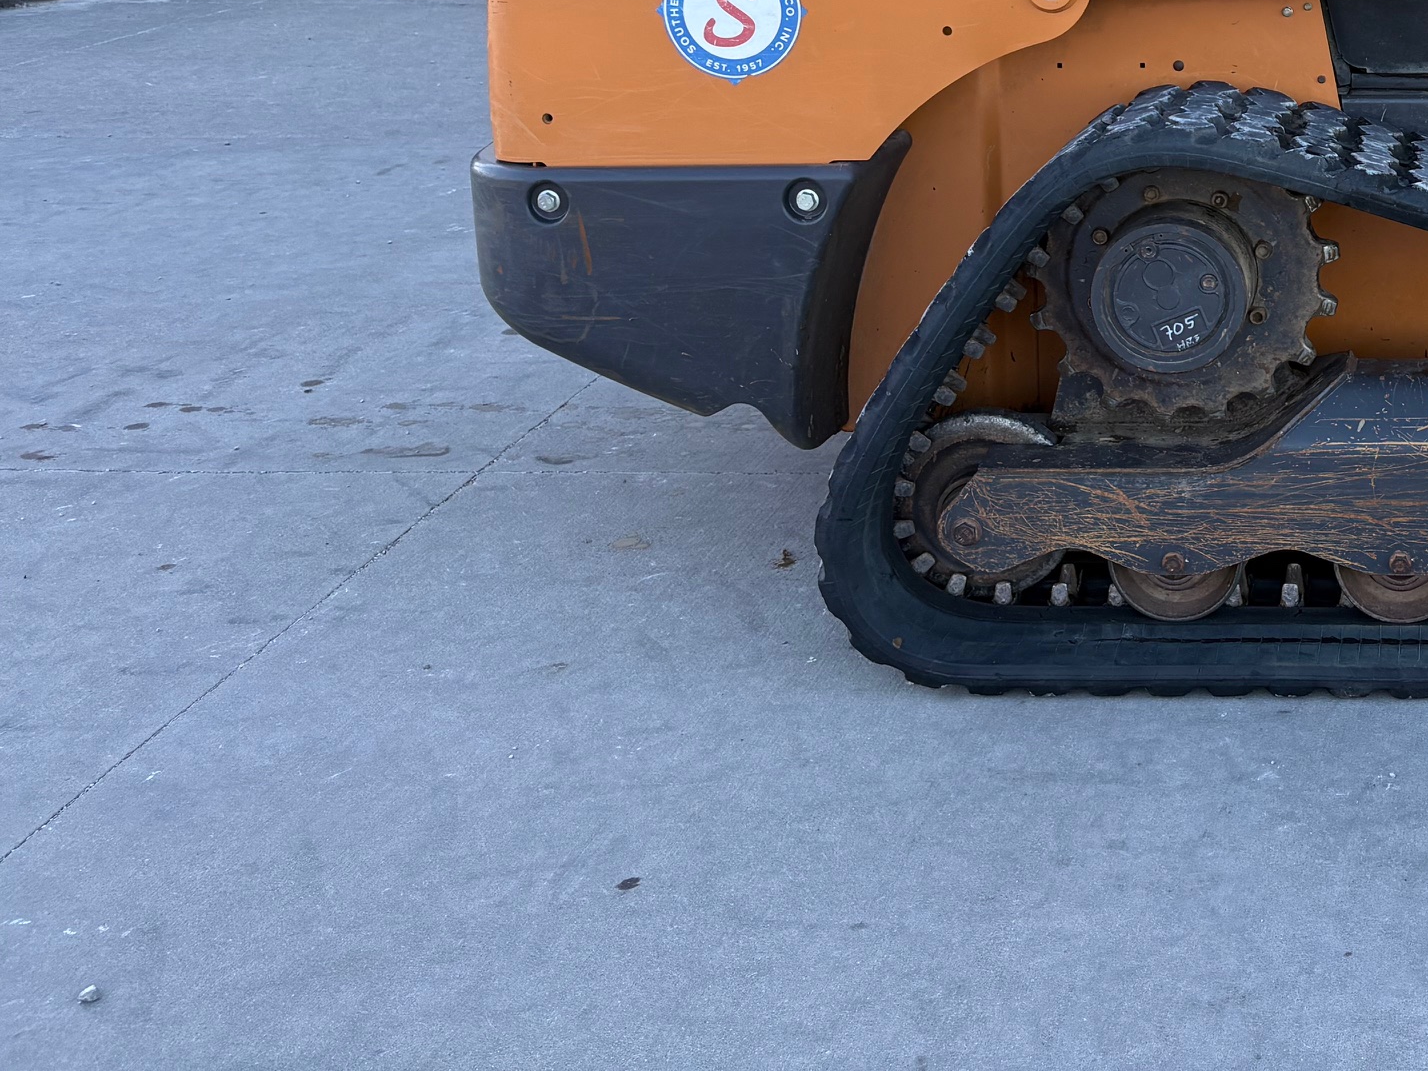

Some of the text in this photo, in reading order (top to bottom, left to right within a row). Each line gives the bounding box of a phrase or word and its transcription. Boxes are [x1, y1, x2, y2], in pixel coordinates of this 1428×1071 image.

[770, 27, 793, 52] INC.
[705, 59, 763, 72] EST. 1957
[1159, 313, 1199, 341] 705
